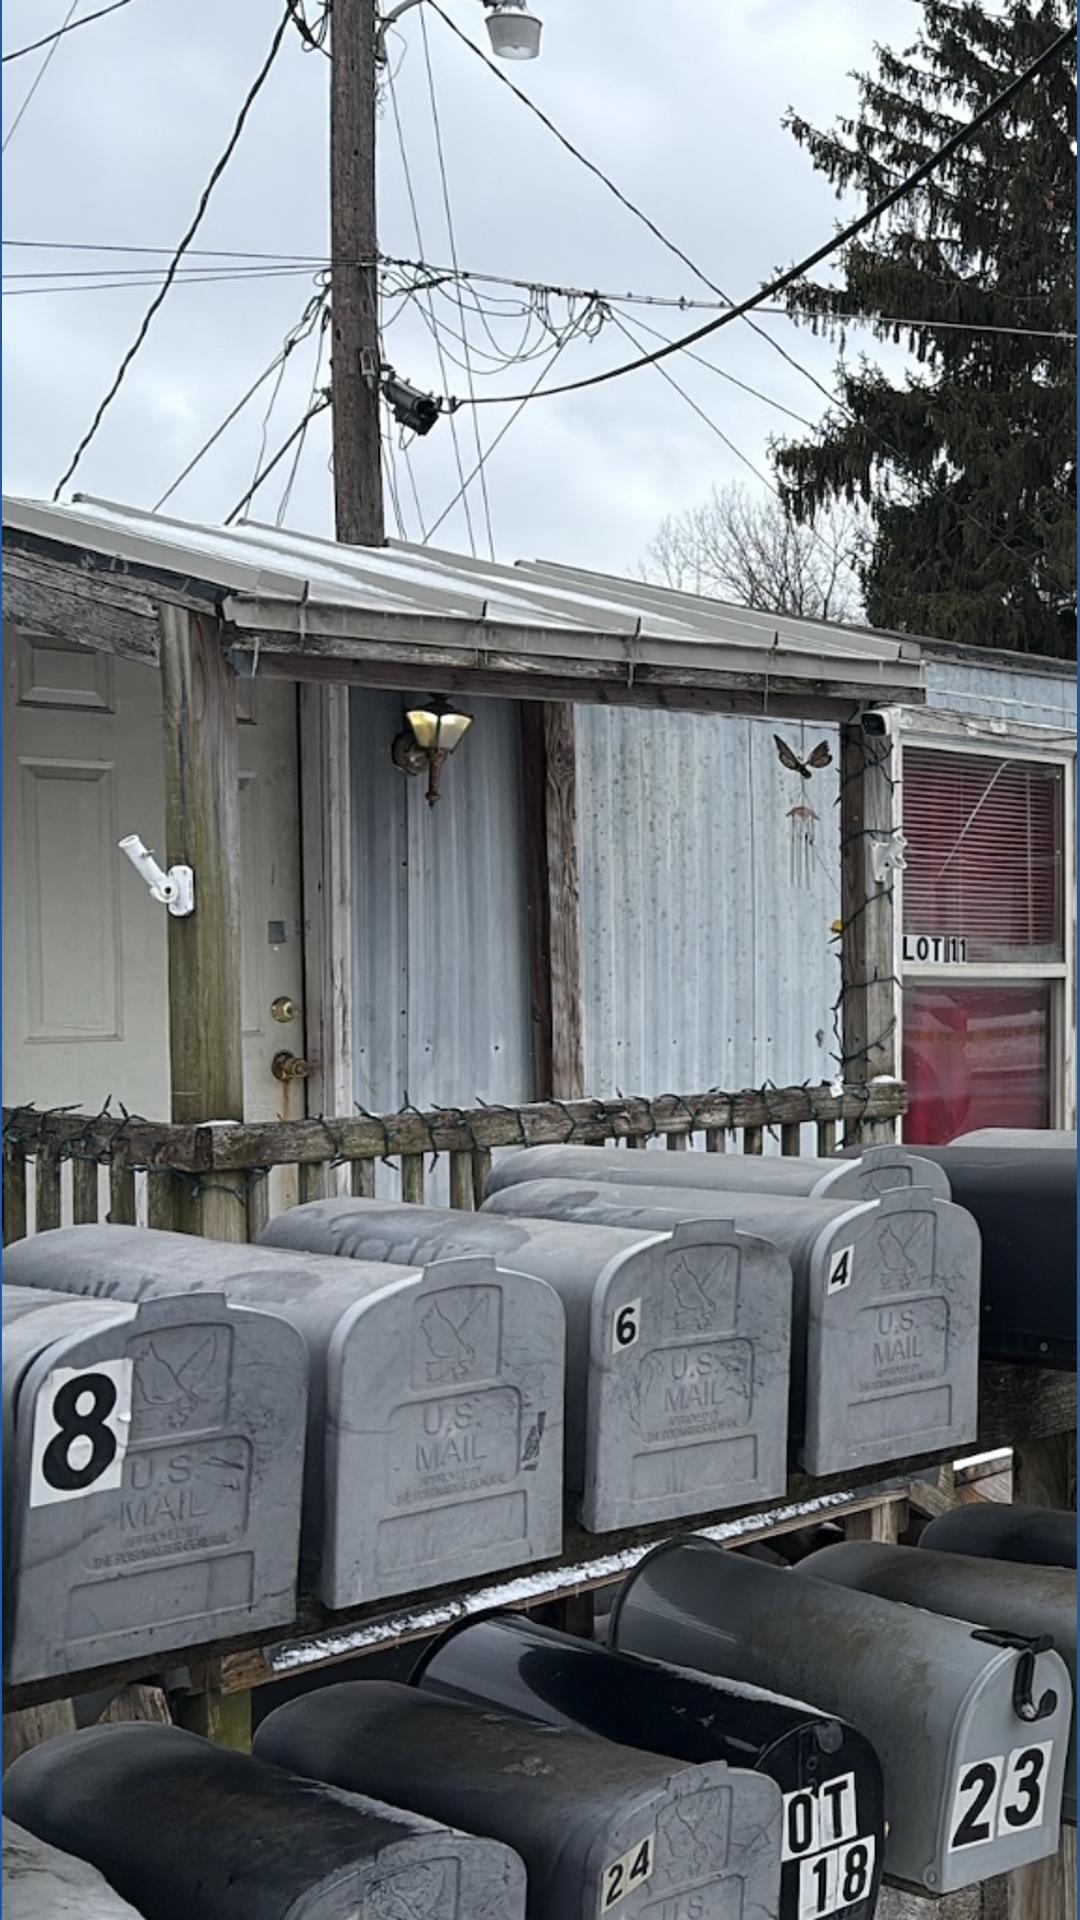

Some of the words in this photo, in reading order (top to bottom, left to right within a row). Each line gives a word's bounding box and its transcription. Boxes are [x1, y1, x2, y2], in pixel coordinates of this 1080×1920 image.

[902, 937, 942, 962] LOT
[950, 937, 967, 962] 11
[830, 1251, 849, 1286] 4
[615, 1306, 637, 1346] 6
[873, 1335, 924, 1365] MAIL
[664, 1380, 724, 1412] MAIL
[41, 1372, 118, 1492] 8
[415, 1433, 488, 1472] MAIL
[119, 1489, 208, 1531] MAIL
[787, 1780, 849, 1854] OT
[951, 1747, 1045, 1848] 23
[605, 1838, 650, 1907] 24
[812, 1844, 869, 1914] 18
